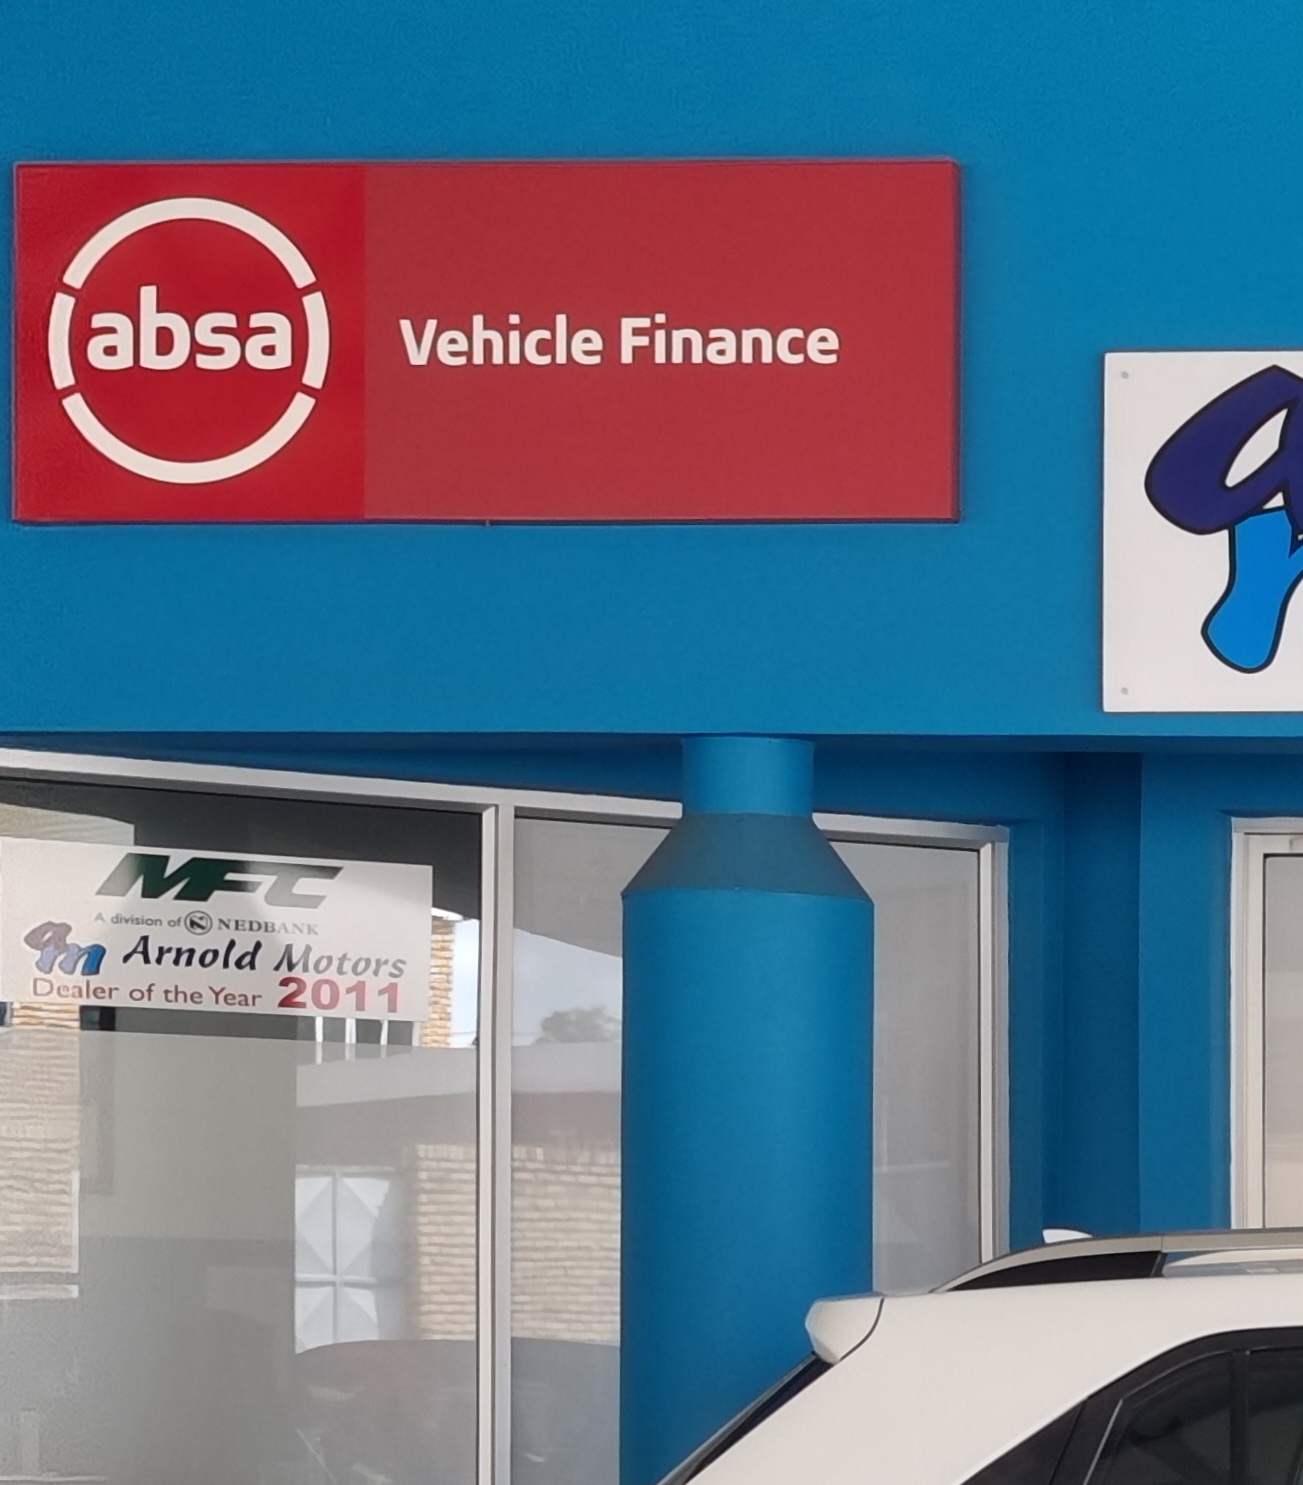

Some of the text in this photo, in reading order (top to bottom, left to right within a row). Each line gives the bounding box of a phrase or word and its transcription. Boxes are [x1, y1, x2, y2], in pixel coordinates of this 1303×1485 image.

[86, 284, 293, 371] absa
[399, 313, 840, 367] Vehicle Finance
[95, 852, 344, 909] MFC
[111, 912, 163, 926] division
[167, 916, 183, 928] of
[217, 917, 320, 936] NEDBANK
[122, 934, 263, 971] Arnold
[273, 943, 408, 979] Motors
[32, 976, 400, 1014] Dealer of the Year 2011
